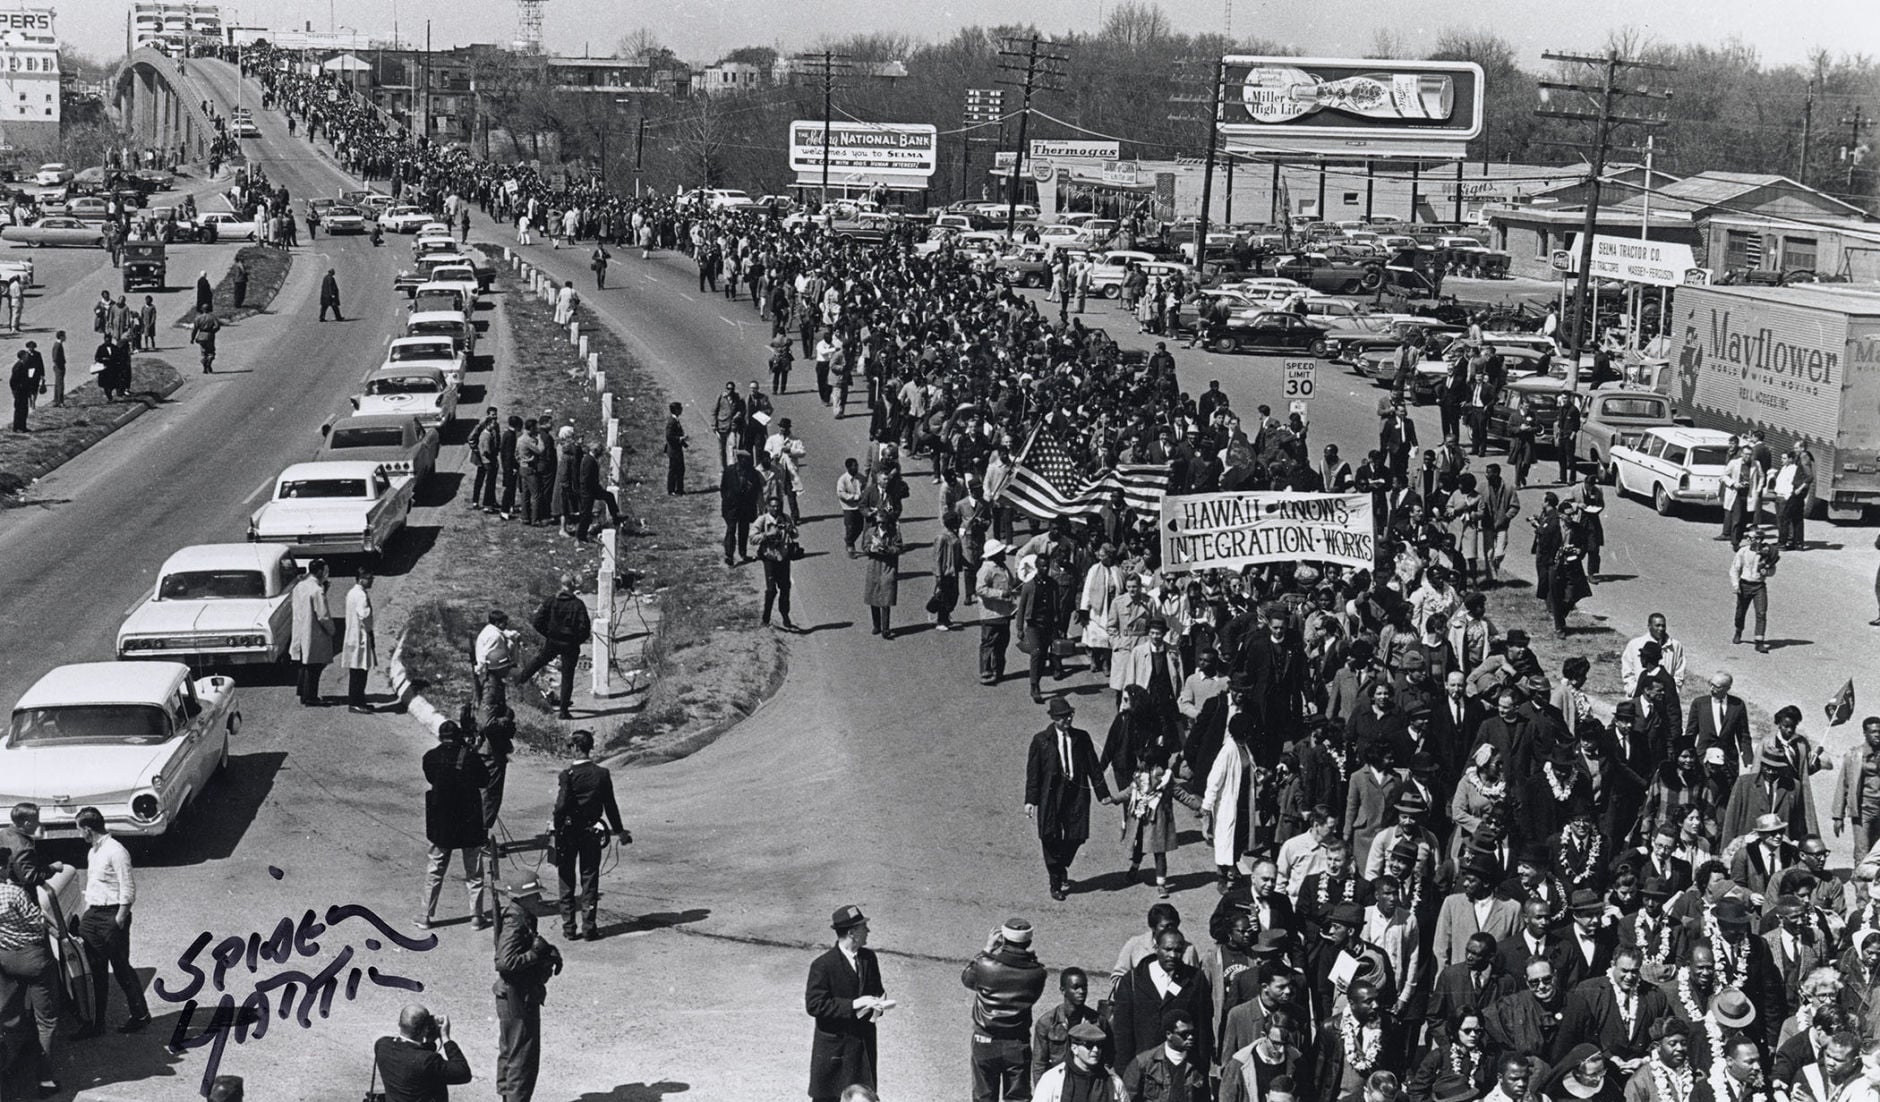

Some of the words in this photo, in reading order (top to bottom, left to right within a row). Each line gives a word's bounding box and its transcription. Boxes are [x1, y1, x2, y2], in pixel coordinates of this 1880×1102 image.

[1252, 91, 1285, 102] Miller
[1251, 103, 1277, 116] High
[1281, 103, 1302, 115] Life
[840, 131, 897, 145] NATIONAL
[899, 134, 930, 147] BANK
[800, 148, 847, 156] welcmes
[852, 150, 867, 158] you
[1033, 144, 1117, 158] Thermogas
[1599, 241, 1617, 257] SELMA
[1619, 244, 1647, 260] TRACTOR
[1651, 248, 1662, 262] CO.
[1708, 308, 1838, 385] Mayflower
[1286, 362, 1315, 370] SPEED
[1289, 371, 1311, 379] LIMIT
[1286, 379, 1313, 395] 30
[1781, 381, 1819, 396] MOVING
[1183, 499, 1262, 530] HAWAII
[1278, 499, 1349, 525] KNOWS
